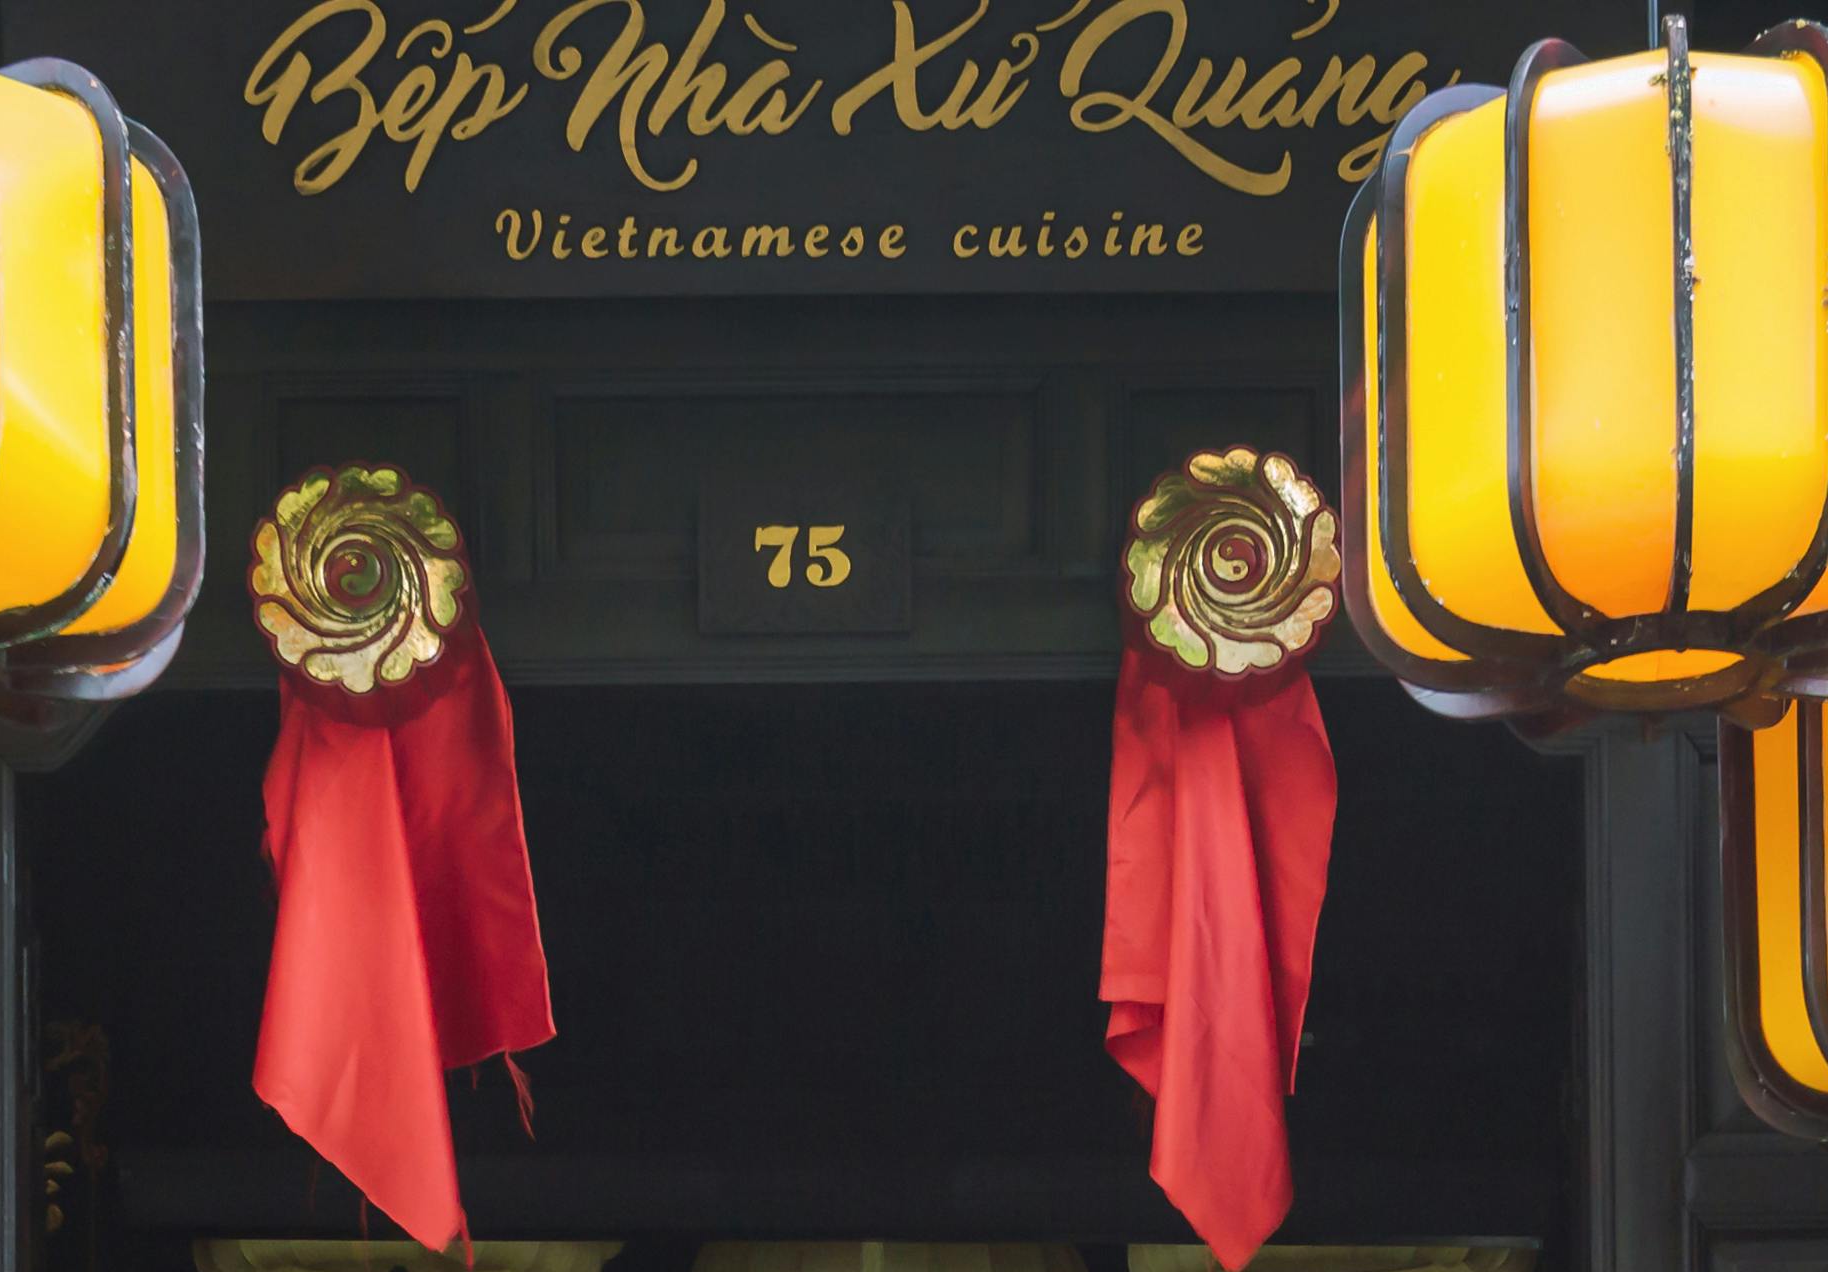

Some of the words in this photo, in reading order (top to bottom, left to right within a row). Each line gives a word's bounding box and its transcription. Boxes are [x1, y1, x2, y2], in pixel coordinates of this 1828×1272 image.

[245, 0, 528, 195] Bếp
[533, 0, 823, 192] Nhà
[495, 208, 907, 260] Vietnamese
[952, 211, 1205, 259] cuisine
[754, 525, 853, 589] 75
